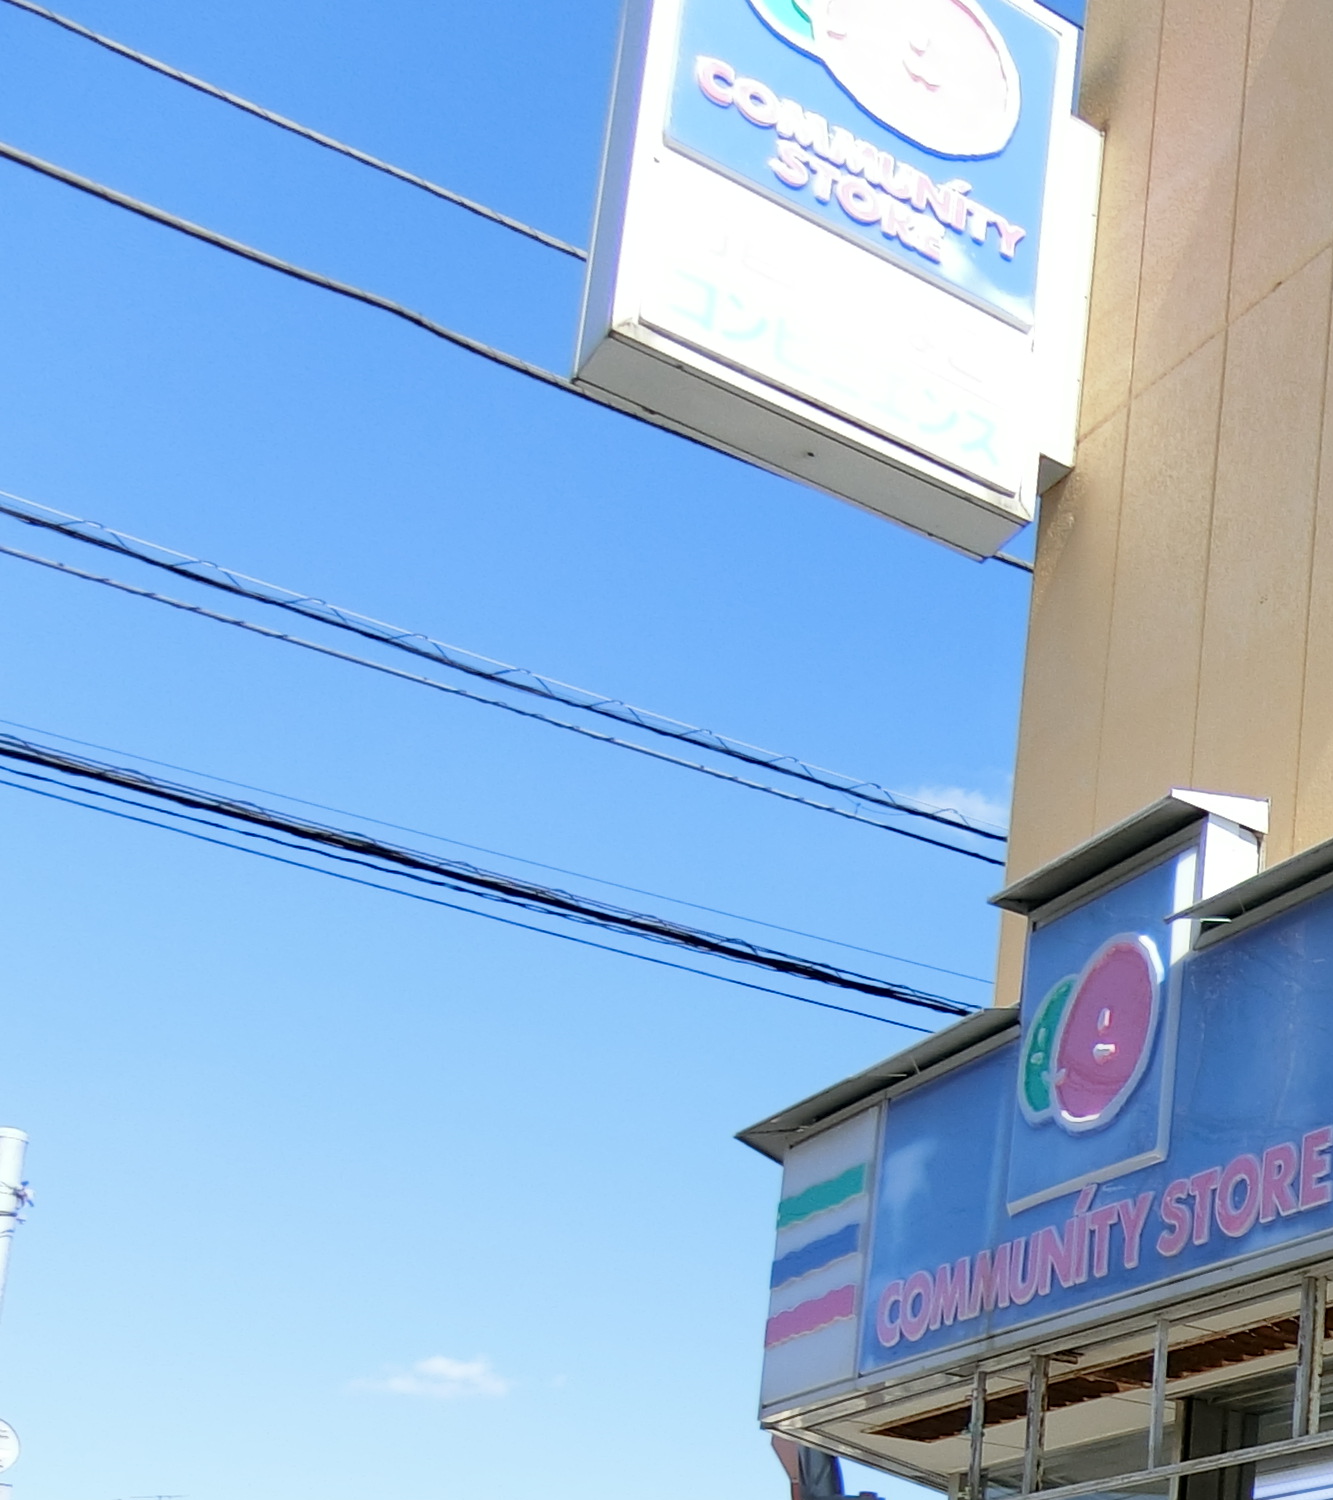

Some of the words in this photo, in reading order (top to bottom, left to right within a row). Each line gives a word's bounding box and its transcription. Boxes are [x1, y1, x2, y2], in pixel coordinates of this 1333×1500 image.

[696, 55, 1026, 260] COMMUNITY
[770, 138, 948, 264] STORE
[876, 1183, 1154, 1348] COMMUNITY
